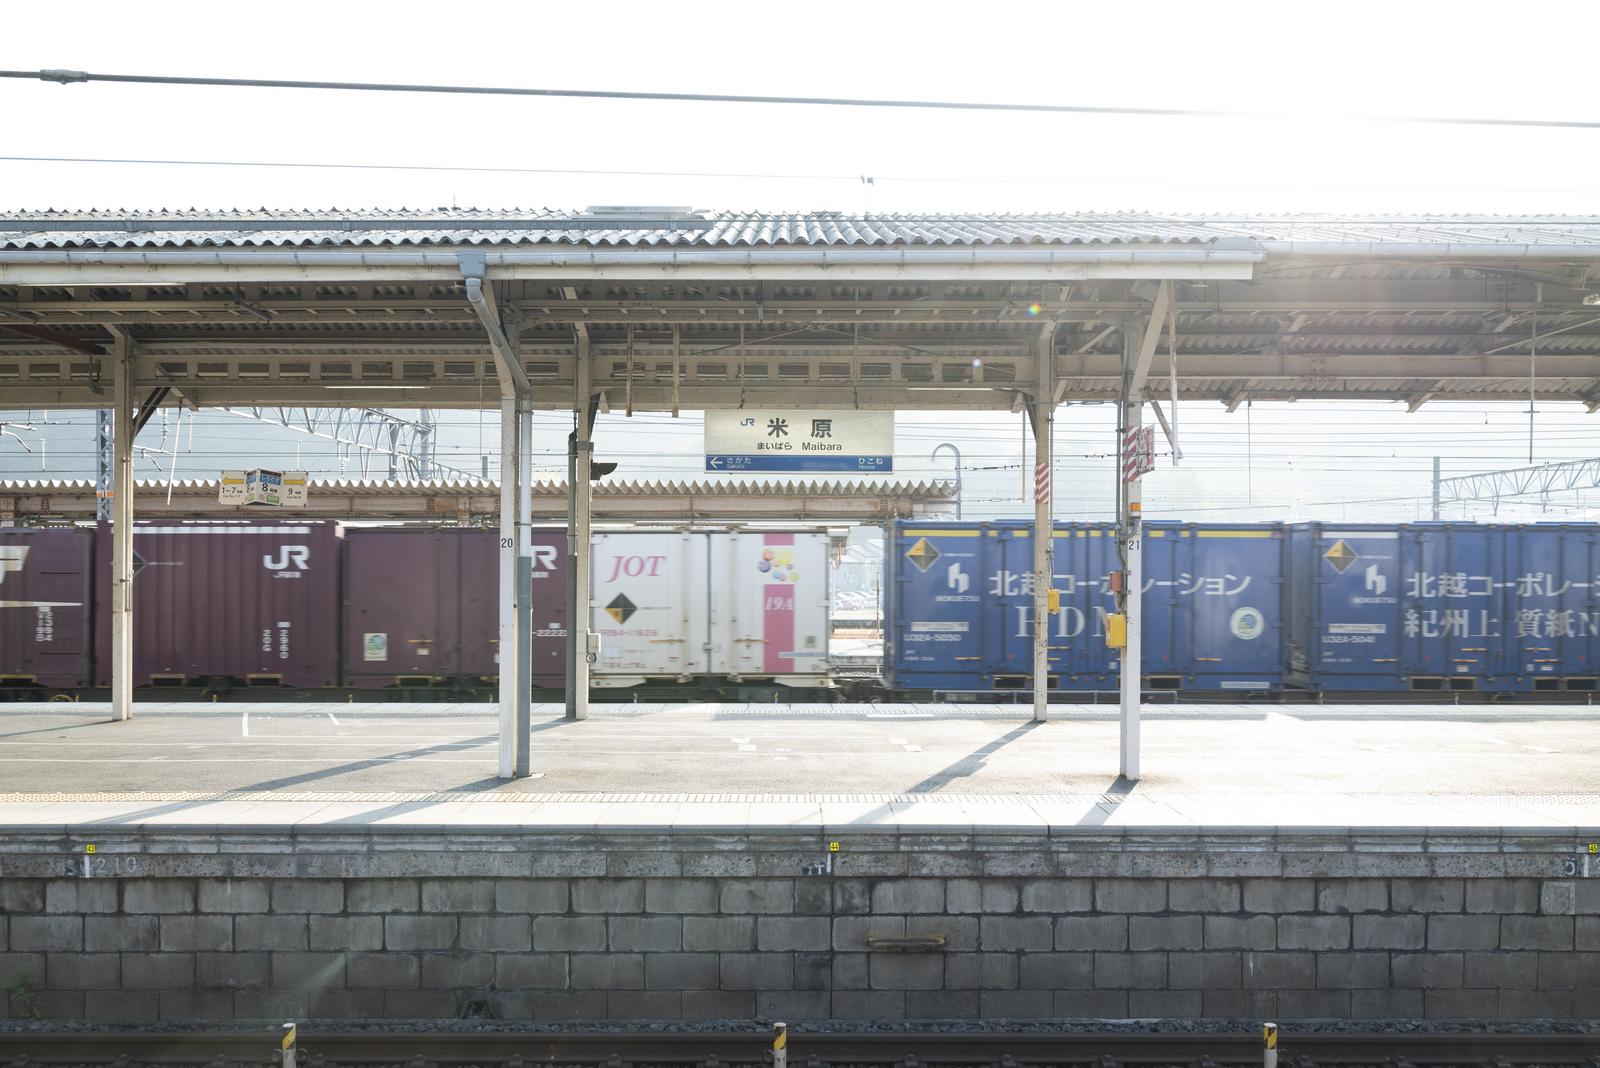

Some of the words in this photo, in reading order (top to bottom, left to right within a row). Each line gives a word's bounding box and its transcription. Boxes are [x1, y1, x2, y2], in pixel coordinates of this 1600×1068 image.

[741, 418, 754, 426] JR
[767, 418, 832, 438] 米原
[757, 442, 793, 450] まいばら
[802, 442, 842, 451] Maibara
[858, 457, 883, 465] ひこね
[501, 538, 513, 548] 20
[1128, 540, 1140, 550] 21
[263, 545, 310, 570] JR
[531, 545, 557, 569] R
[605, 556, 666, 583] JOT
[1406, 572, 1600, 597] 北越コーポレー
[87, 845, 95, 853] 43
